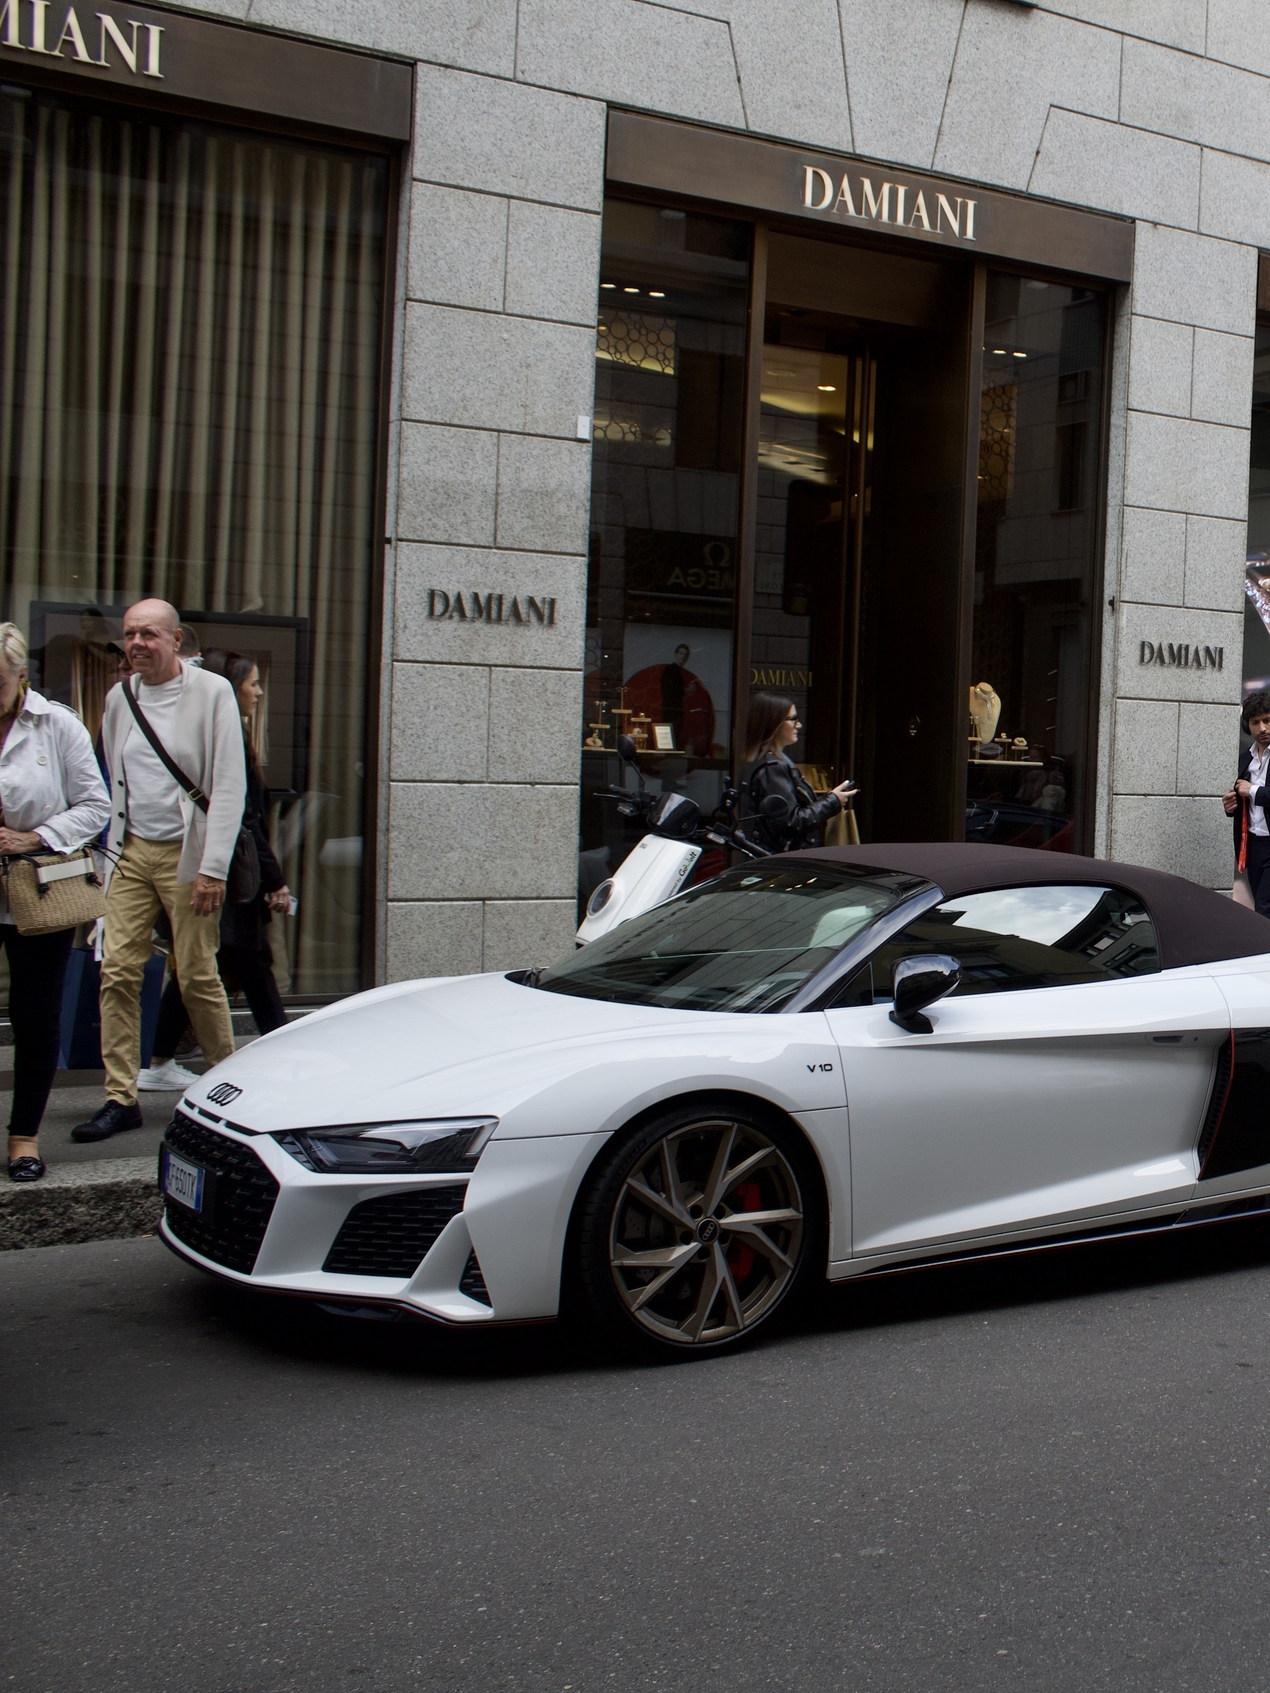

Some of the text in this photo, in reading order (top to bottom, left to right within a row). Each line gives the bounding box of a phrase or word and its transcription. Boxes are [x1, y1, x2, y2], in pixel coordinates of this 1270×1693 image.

[802, 165, 978, 242] DAMIANI
[427, 588, 557, 626] DAMIANI
[1140, 640, 1224, 670] DAMIANI
[750, 667, 813, 687] DAMIANI
